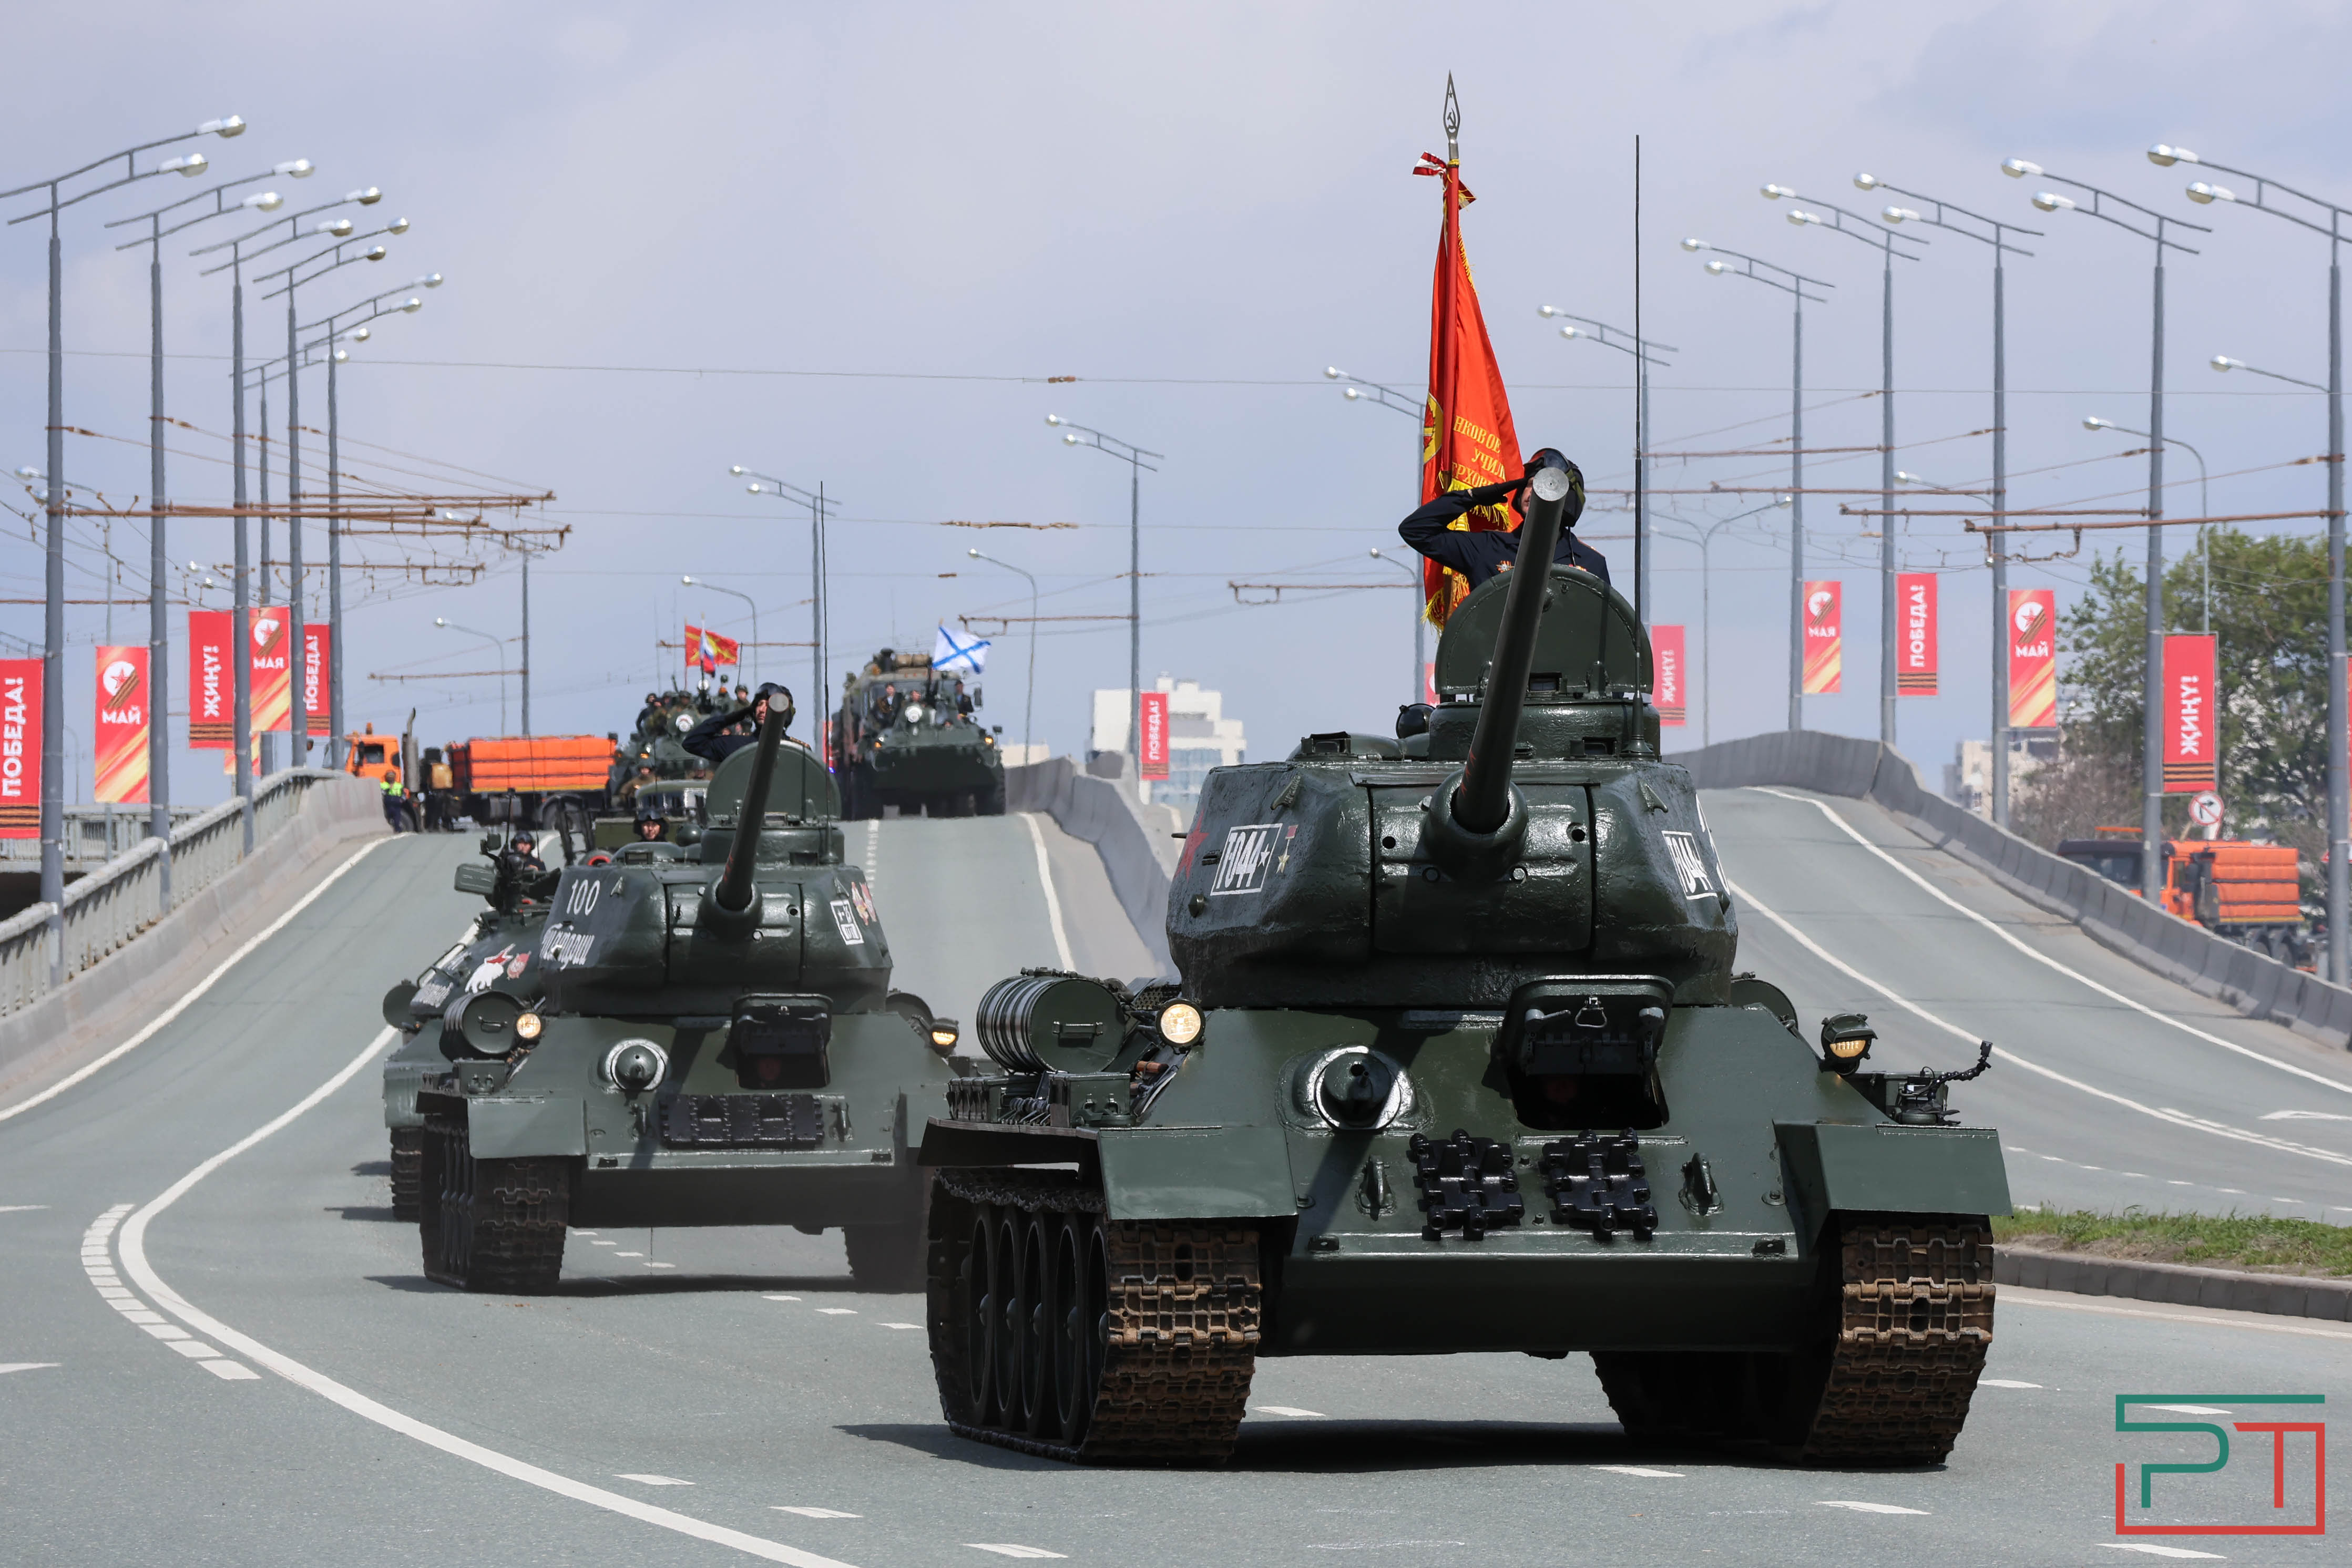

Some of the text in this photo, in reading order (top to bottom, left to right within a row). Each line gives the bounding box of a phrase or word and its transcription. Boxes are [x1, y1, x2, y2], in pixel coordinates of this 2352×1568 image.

[1453, 415, 1501, 453] НКОВОЕ
[1471, 448, 1506, 482] УЧИЛ
[1808, 626, 1836, 637] МАЯ
[1910, 585, 1927, 667] ПОБЕДА!
[253, 657, 284, 669] МАЯ
[2015, 640, 2049, 658] МАЙ
[305, 634, 321, 711] ПОБЕДА!
[102, 705, 141, 724] МАЙ
[1148, 700, 1162, 760] ПОБЕДА!
[2, 677, 26, 796] ПОБЕДА!
[566, 879, 600, 916] 100
